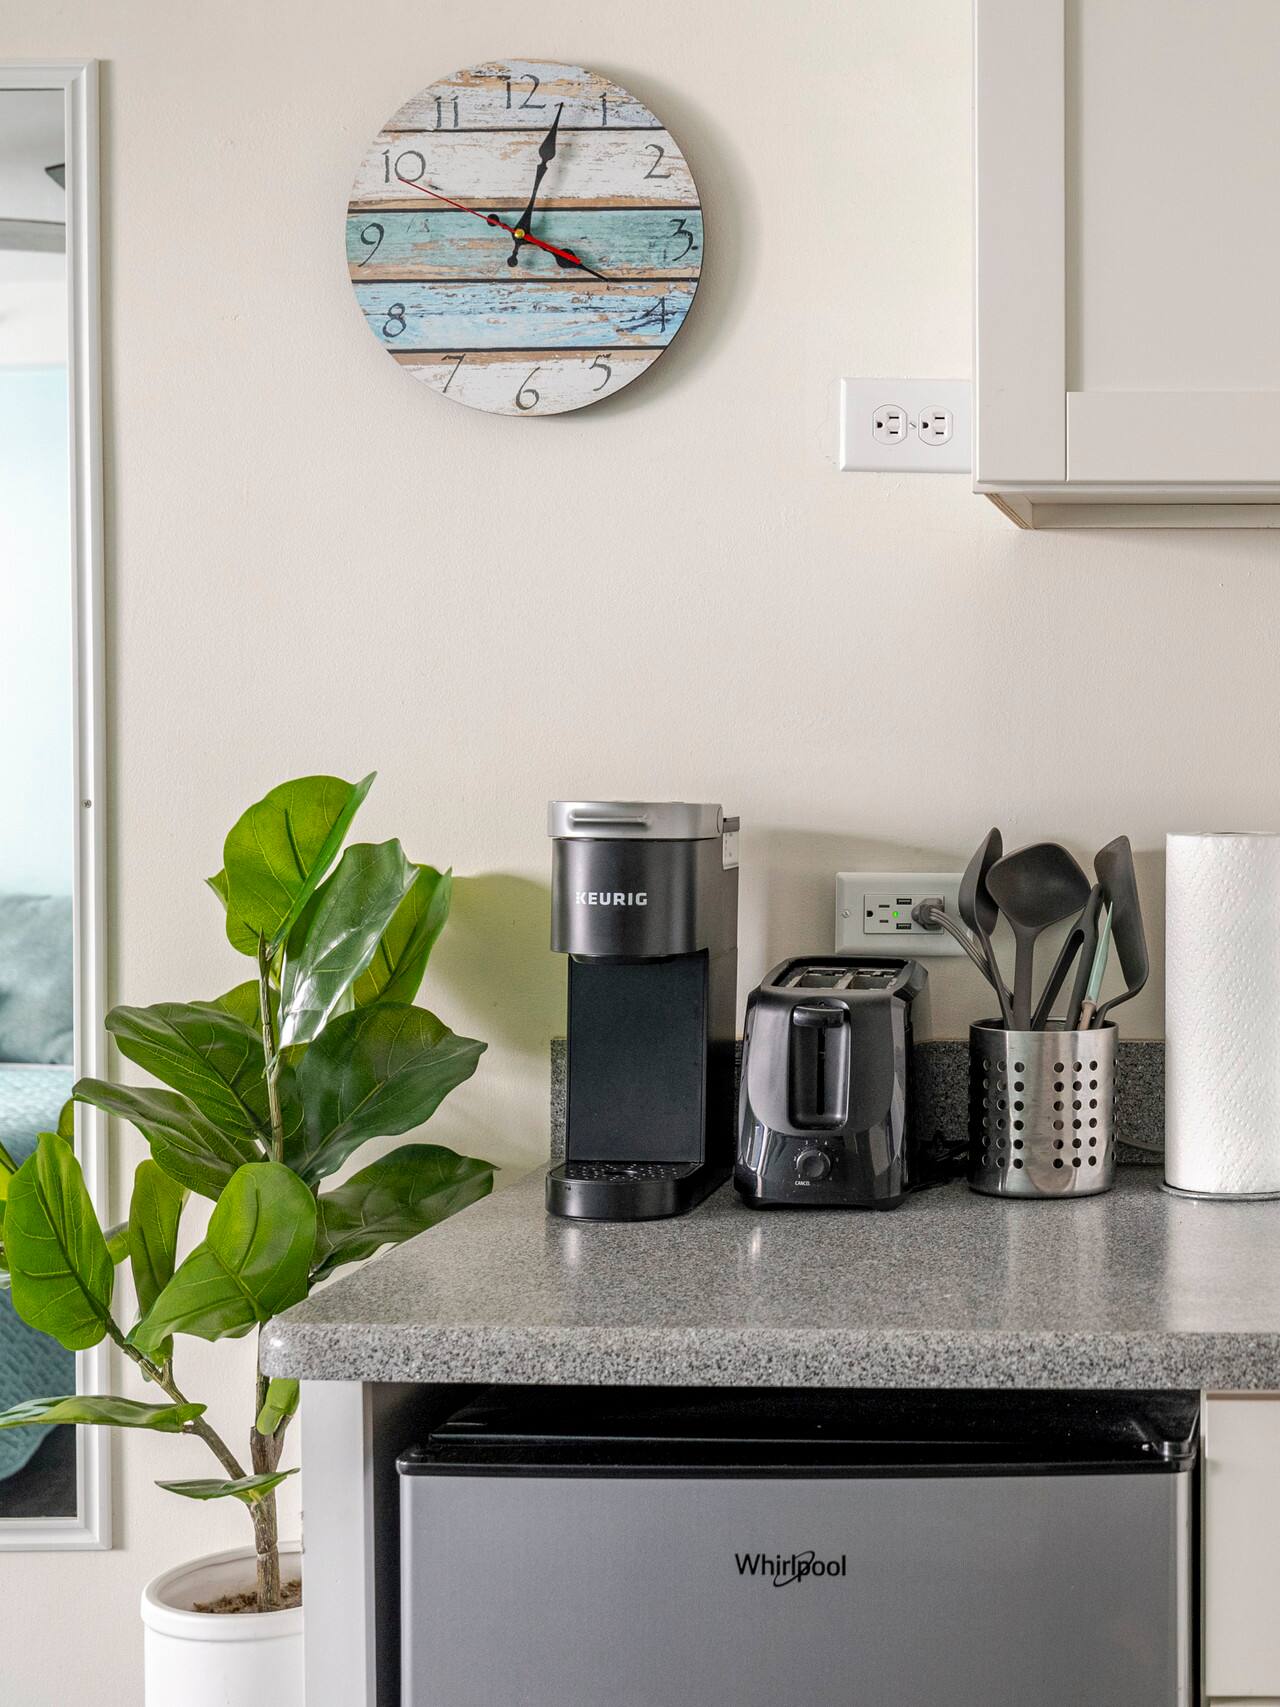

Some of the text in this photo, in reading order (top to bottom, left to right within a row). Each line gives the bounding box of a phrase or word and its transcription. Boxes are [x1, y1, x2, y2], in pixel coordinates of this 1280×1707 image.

[504, 73, 547, 110] 12
[599, 92, 608, 126] 1
[433, 95, 459, 128] 11
[383, 149, 426, 183] 10
[643, 144, 671, 180] 2
[357, 222, 385, 268] 9
[669, 218, 694, 262] 3
[382, 302, 406, 338] 8
[639, 296, 672, 334] 4
[441, 353, 466, 393] 7
[515, 366, 540, 411] 6
[589, 353, 612, 392] 5
[575, 891, 648, 906] KEURIG
[734, 1550, 846, 1587] Whirlpool
